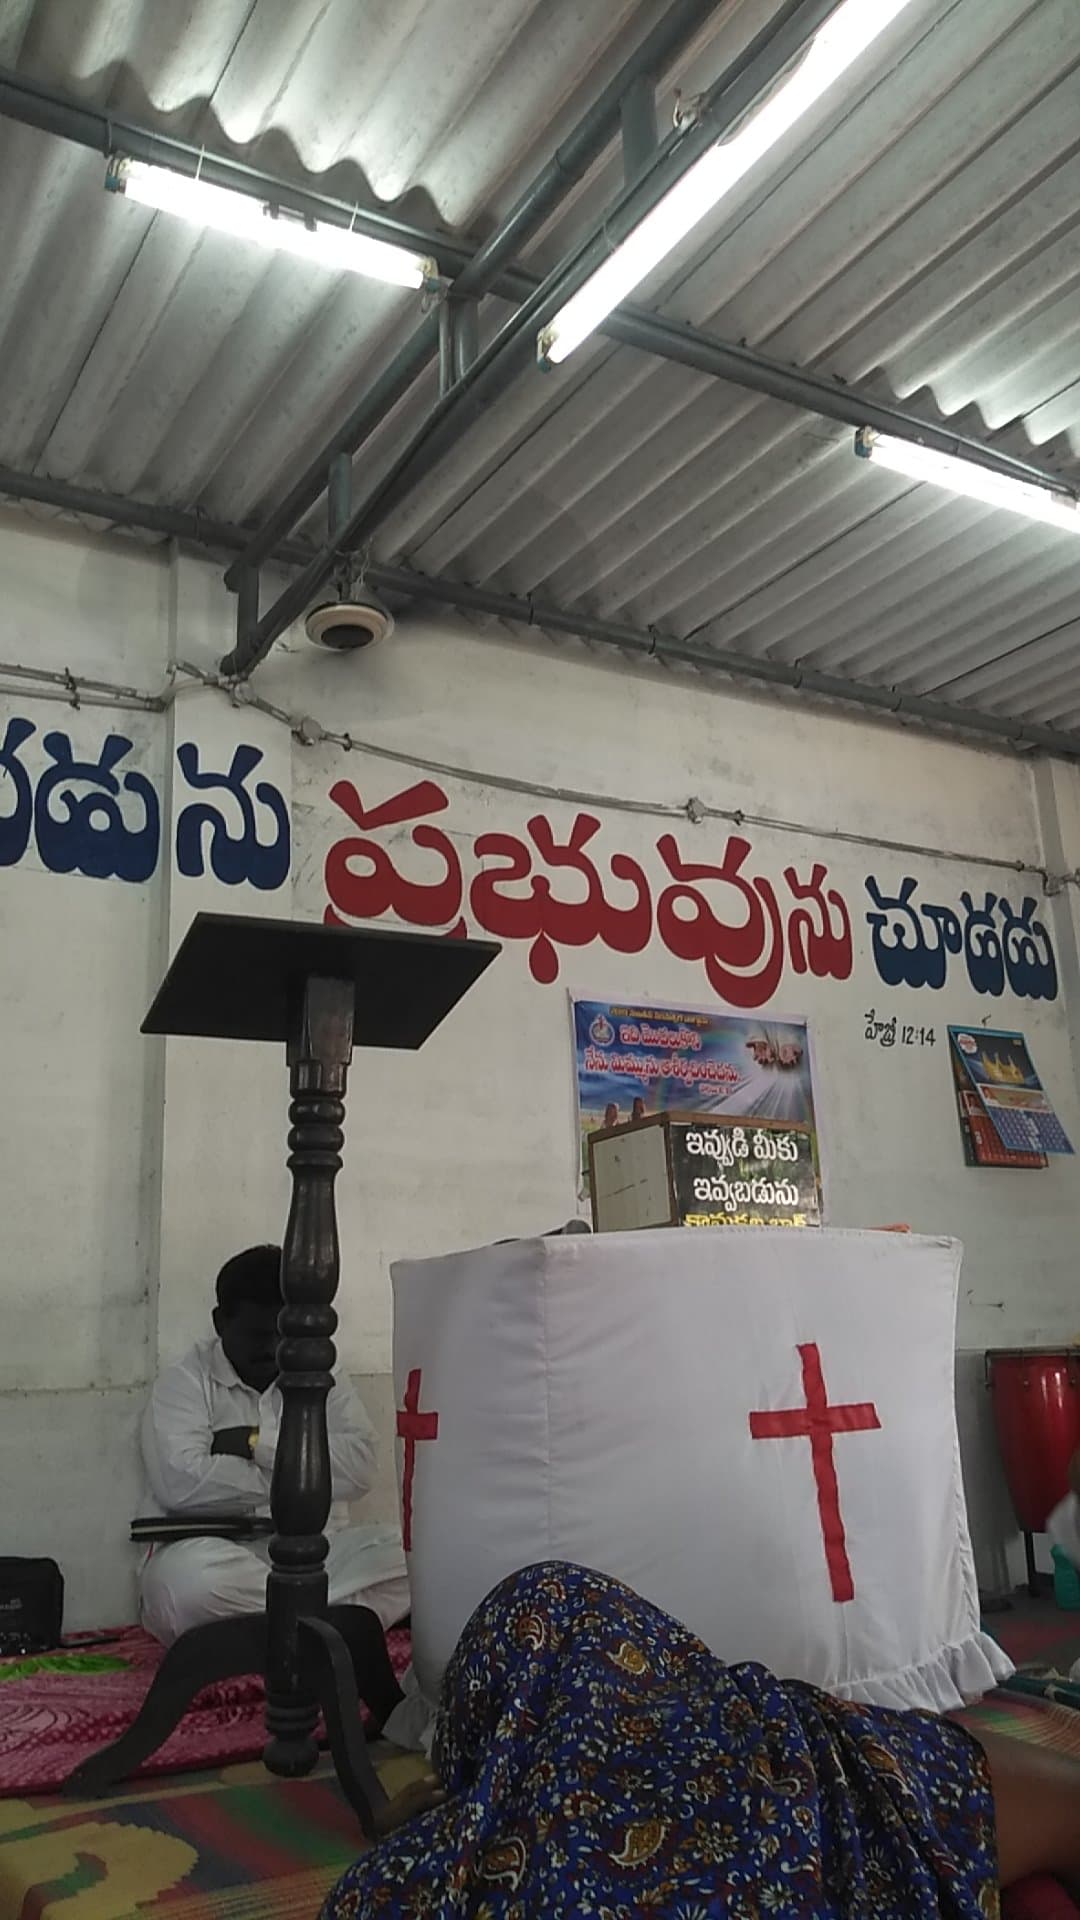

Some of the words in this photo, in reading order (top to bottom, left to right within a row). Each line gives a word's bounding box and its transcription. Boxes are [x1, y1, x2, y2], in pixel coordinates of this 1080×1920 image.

[864, 875, 1059, 1001] చూడడు
[902, 1025, 936, 1047] 12:14
[754, 1128, 798, 1162] మీకు
[693, 1174, 799, 1212] ఇవ్వబడును
